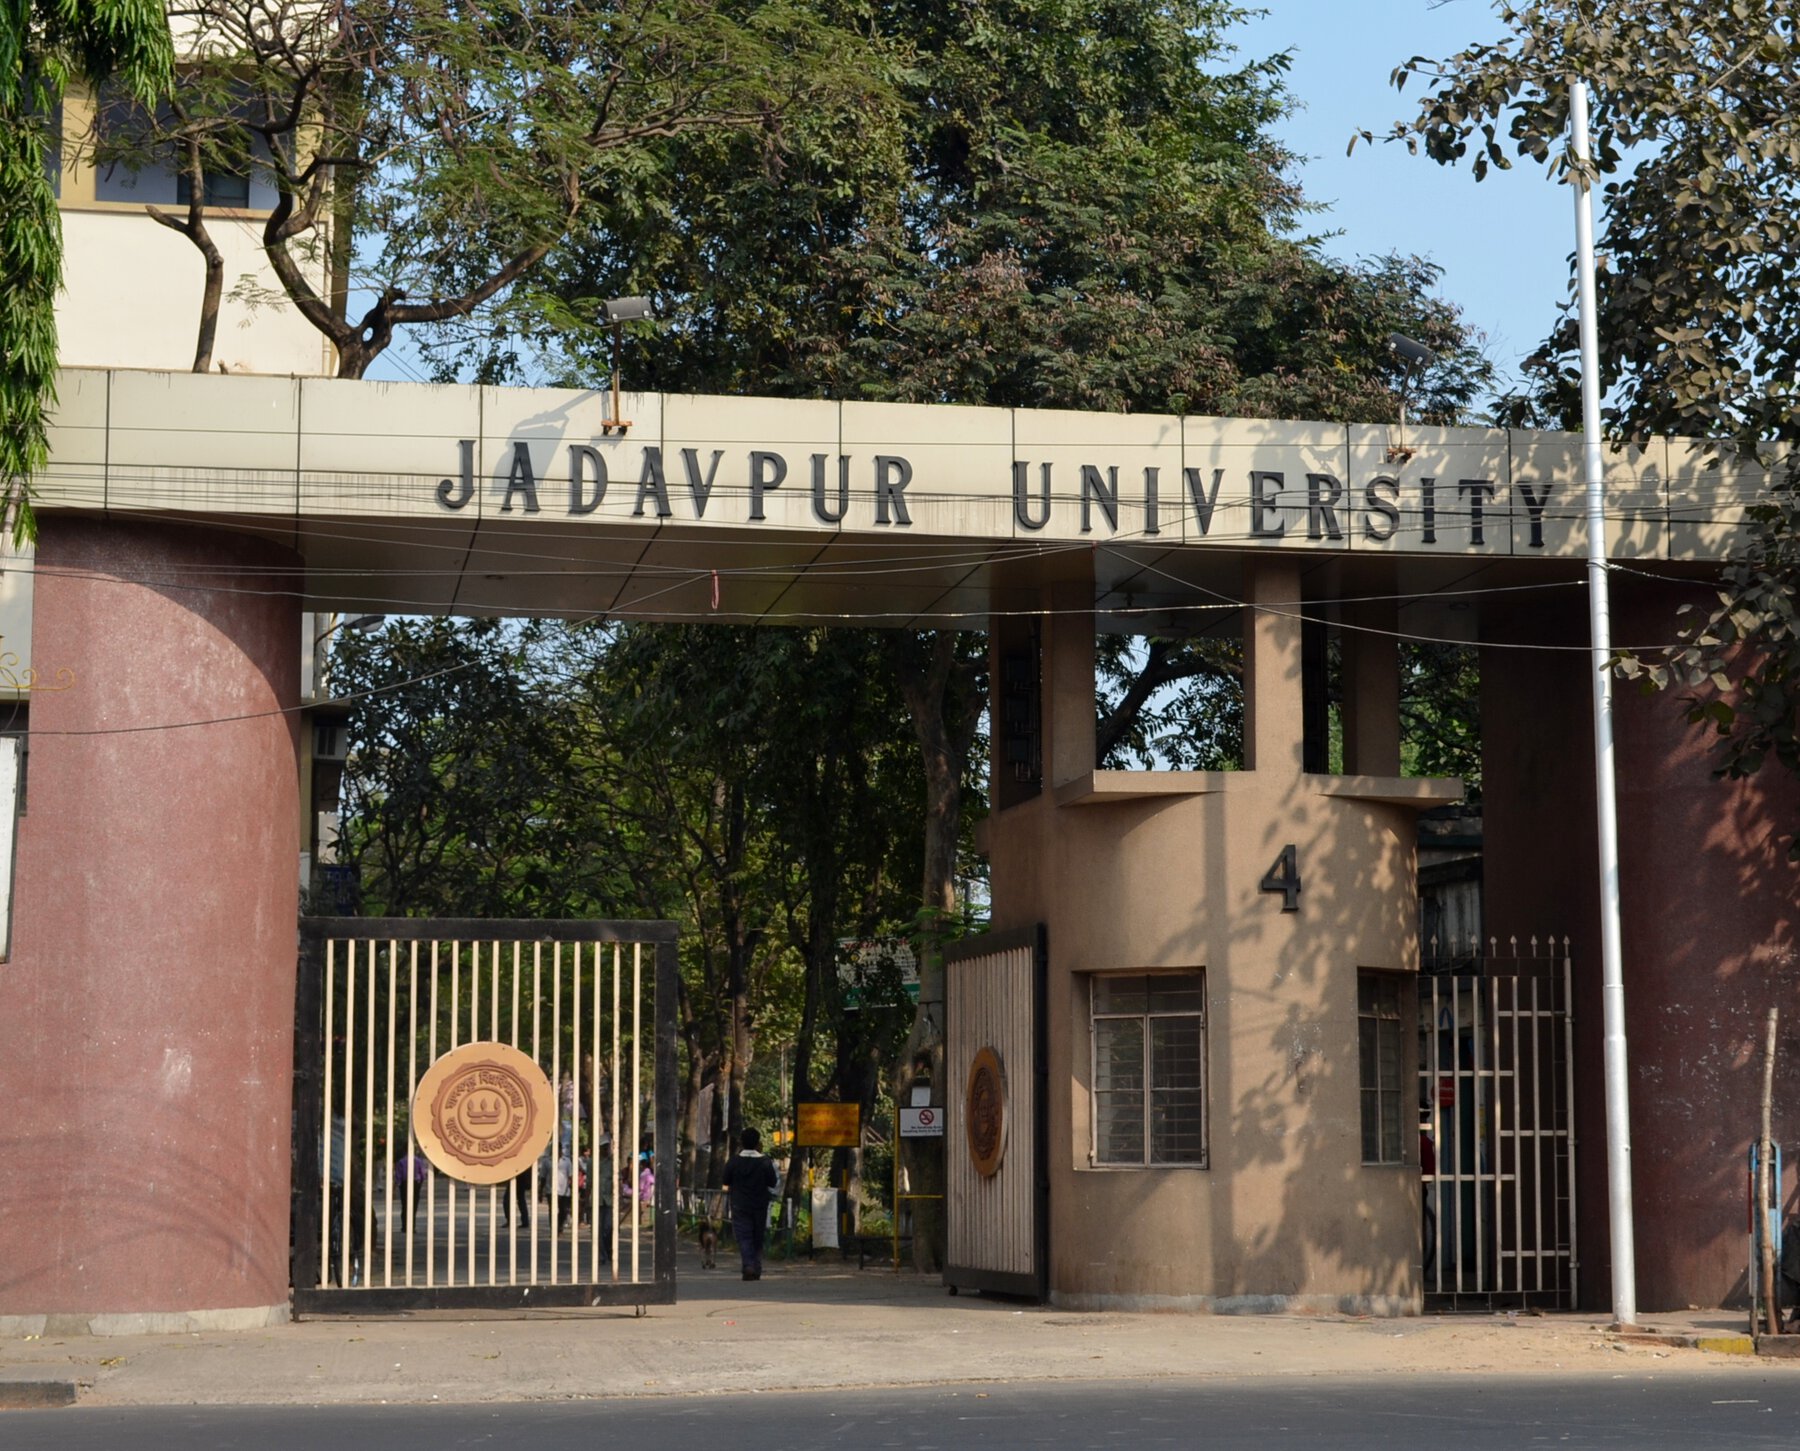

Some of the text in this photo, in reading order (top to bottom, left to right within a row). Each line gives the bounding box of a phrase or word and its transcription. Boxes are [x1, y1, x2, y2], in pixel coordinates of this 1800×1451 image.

[437, 439, 1555, 548] JADAVPUR UNIVERSITY
[1259, 844, 1301, 912] 4
